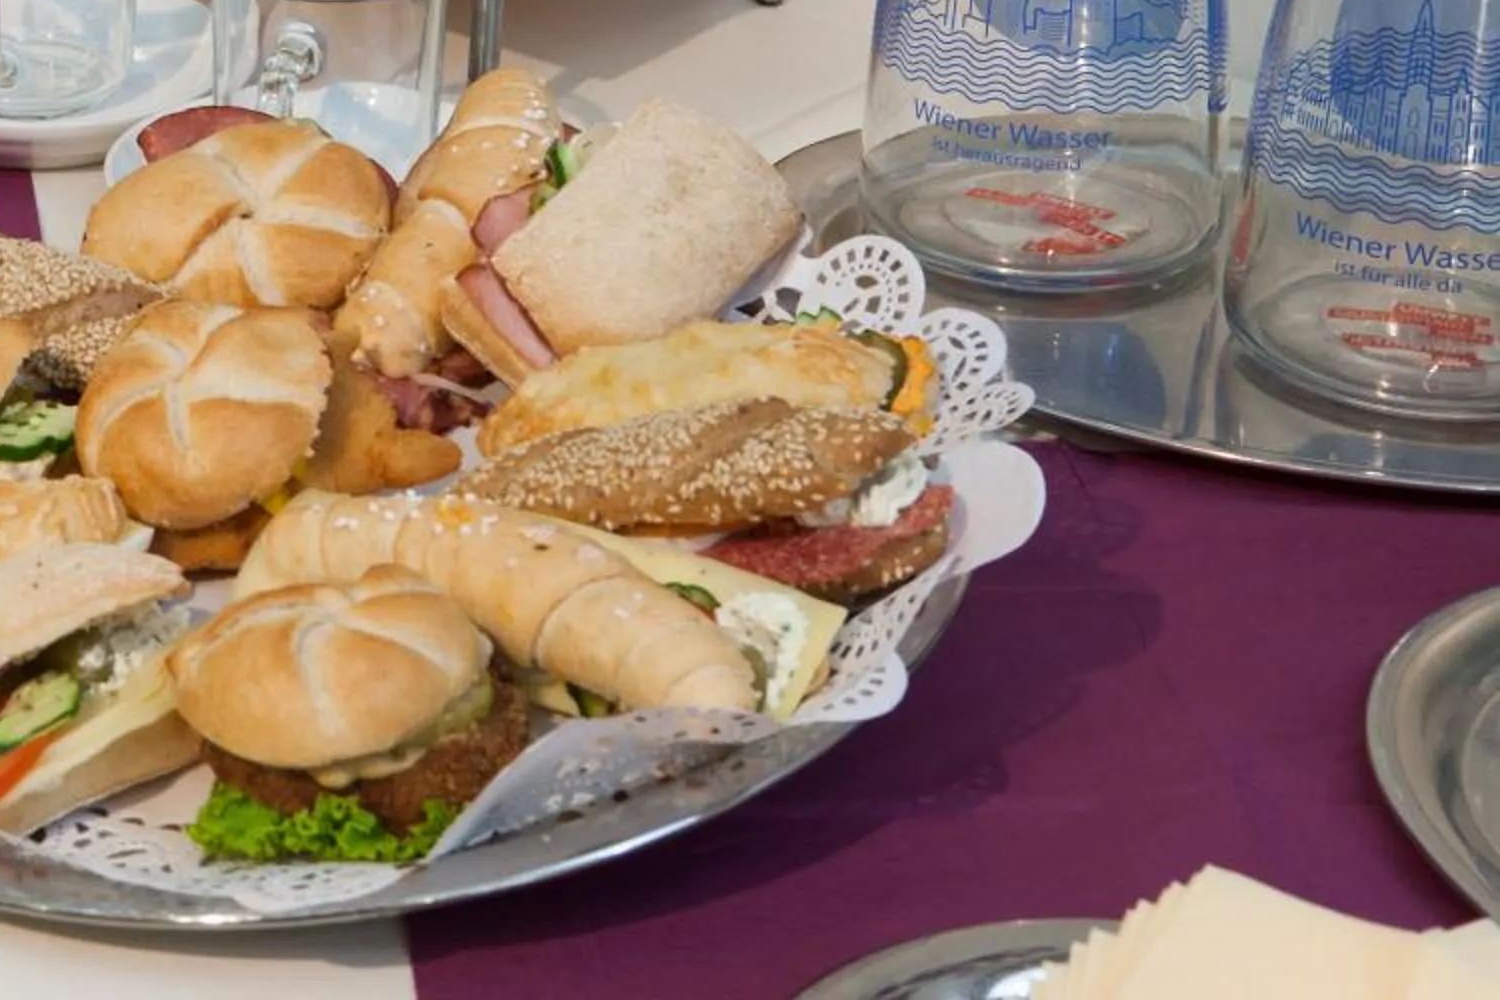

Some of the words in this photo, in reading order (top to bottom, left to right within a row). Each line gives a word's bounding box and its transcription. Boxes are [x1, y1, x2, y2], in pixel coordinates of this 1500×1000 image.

[912, 97, 1003, 140] Wiener
[1007, 121, 1114, 150] Wasser
[1295, 209, 1397, 261] Wiener
[1334, 260, 1355, 277] ist
[1361, 265, 1391, 286] für
[1394, 272, 1431, 292] alle
[1436, 276, 1462, 294] da
